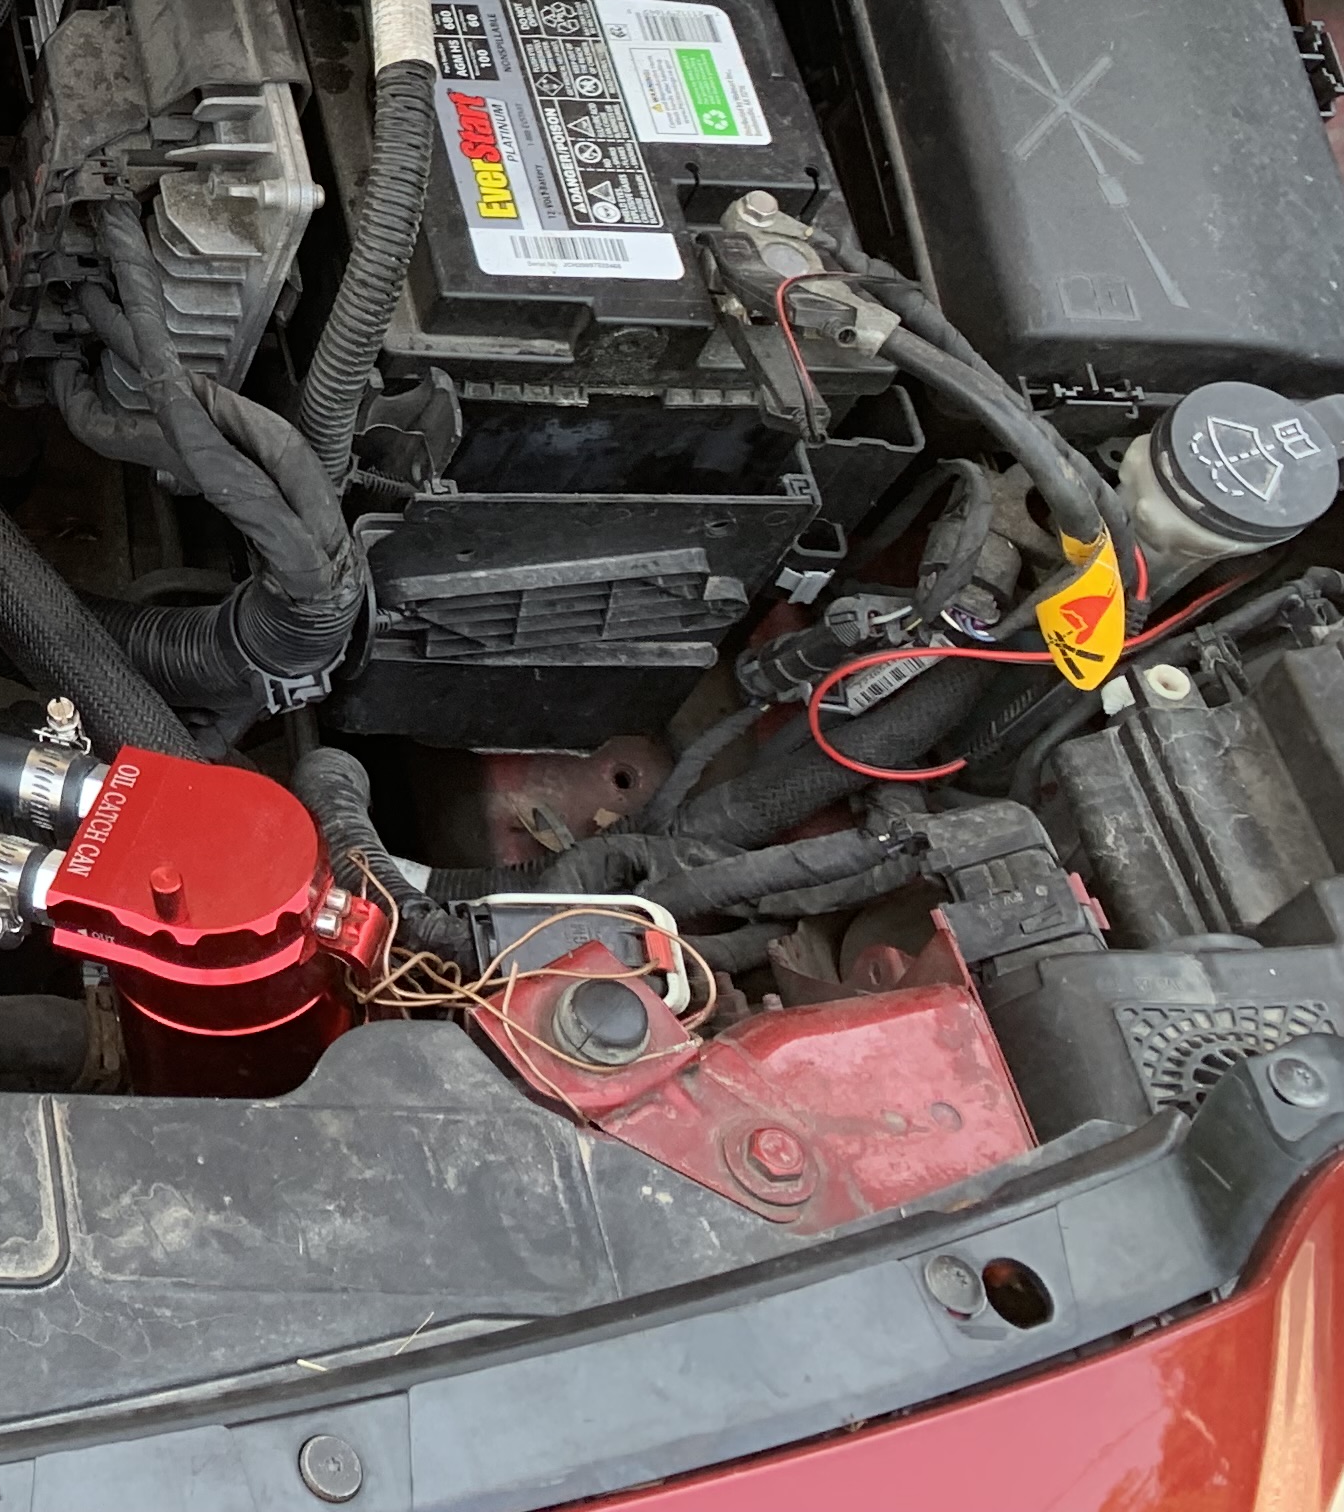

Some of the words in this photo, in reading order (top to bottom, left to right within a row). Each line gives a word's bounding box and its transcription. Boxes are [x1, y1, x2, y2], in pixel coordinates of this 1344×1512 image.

[439, 10, 456, 30] 680
[466, 13, 480, 28] 60
[513, 2, 526, 18] NOT
[518, 18, 530, 30] DO
[448, 39, 461, 53] HS
[487, 13, 512, 73] NONSPILLABLE
[452, 54, 468, 77] AGM
[476, 49, 492, 68] 100
[491, 103, 519, 163] PLATINUM
[447, 90, 519, 220] EverStart
[544, 108, 584, 203] DANGER/POISON
[109, 764, 141, 789] OIL
[83, 791, 127, 844] CATCH
[66, 843, 101, 878] CAN
